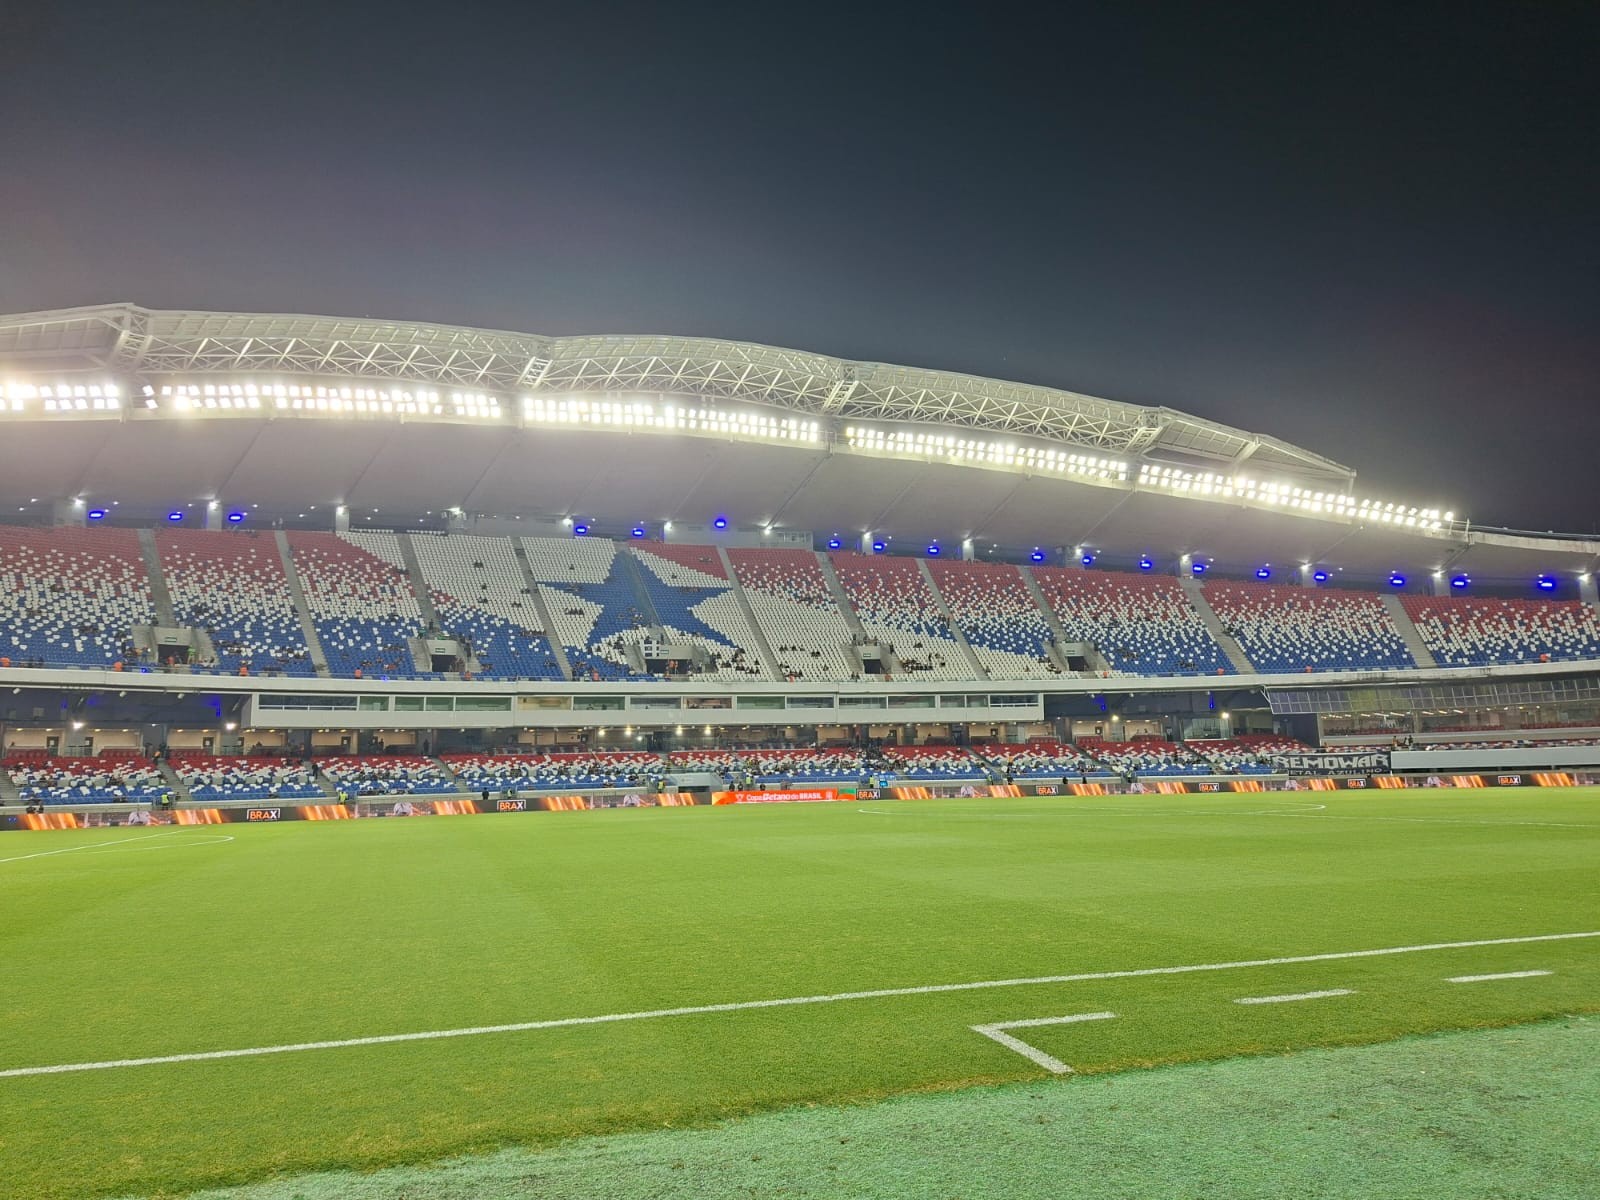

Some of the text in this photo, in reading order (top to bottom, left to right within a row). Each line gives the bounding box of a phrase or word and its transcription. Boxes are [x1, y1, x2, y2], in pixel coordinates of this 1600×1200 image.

[1272, 754, 1388, 769] REMOWAR
[499, 801, 524, 810] BRAX
[250, 810, 277, 819] BRAX
